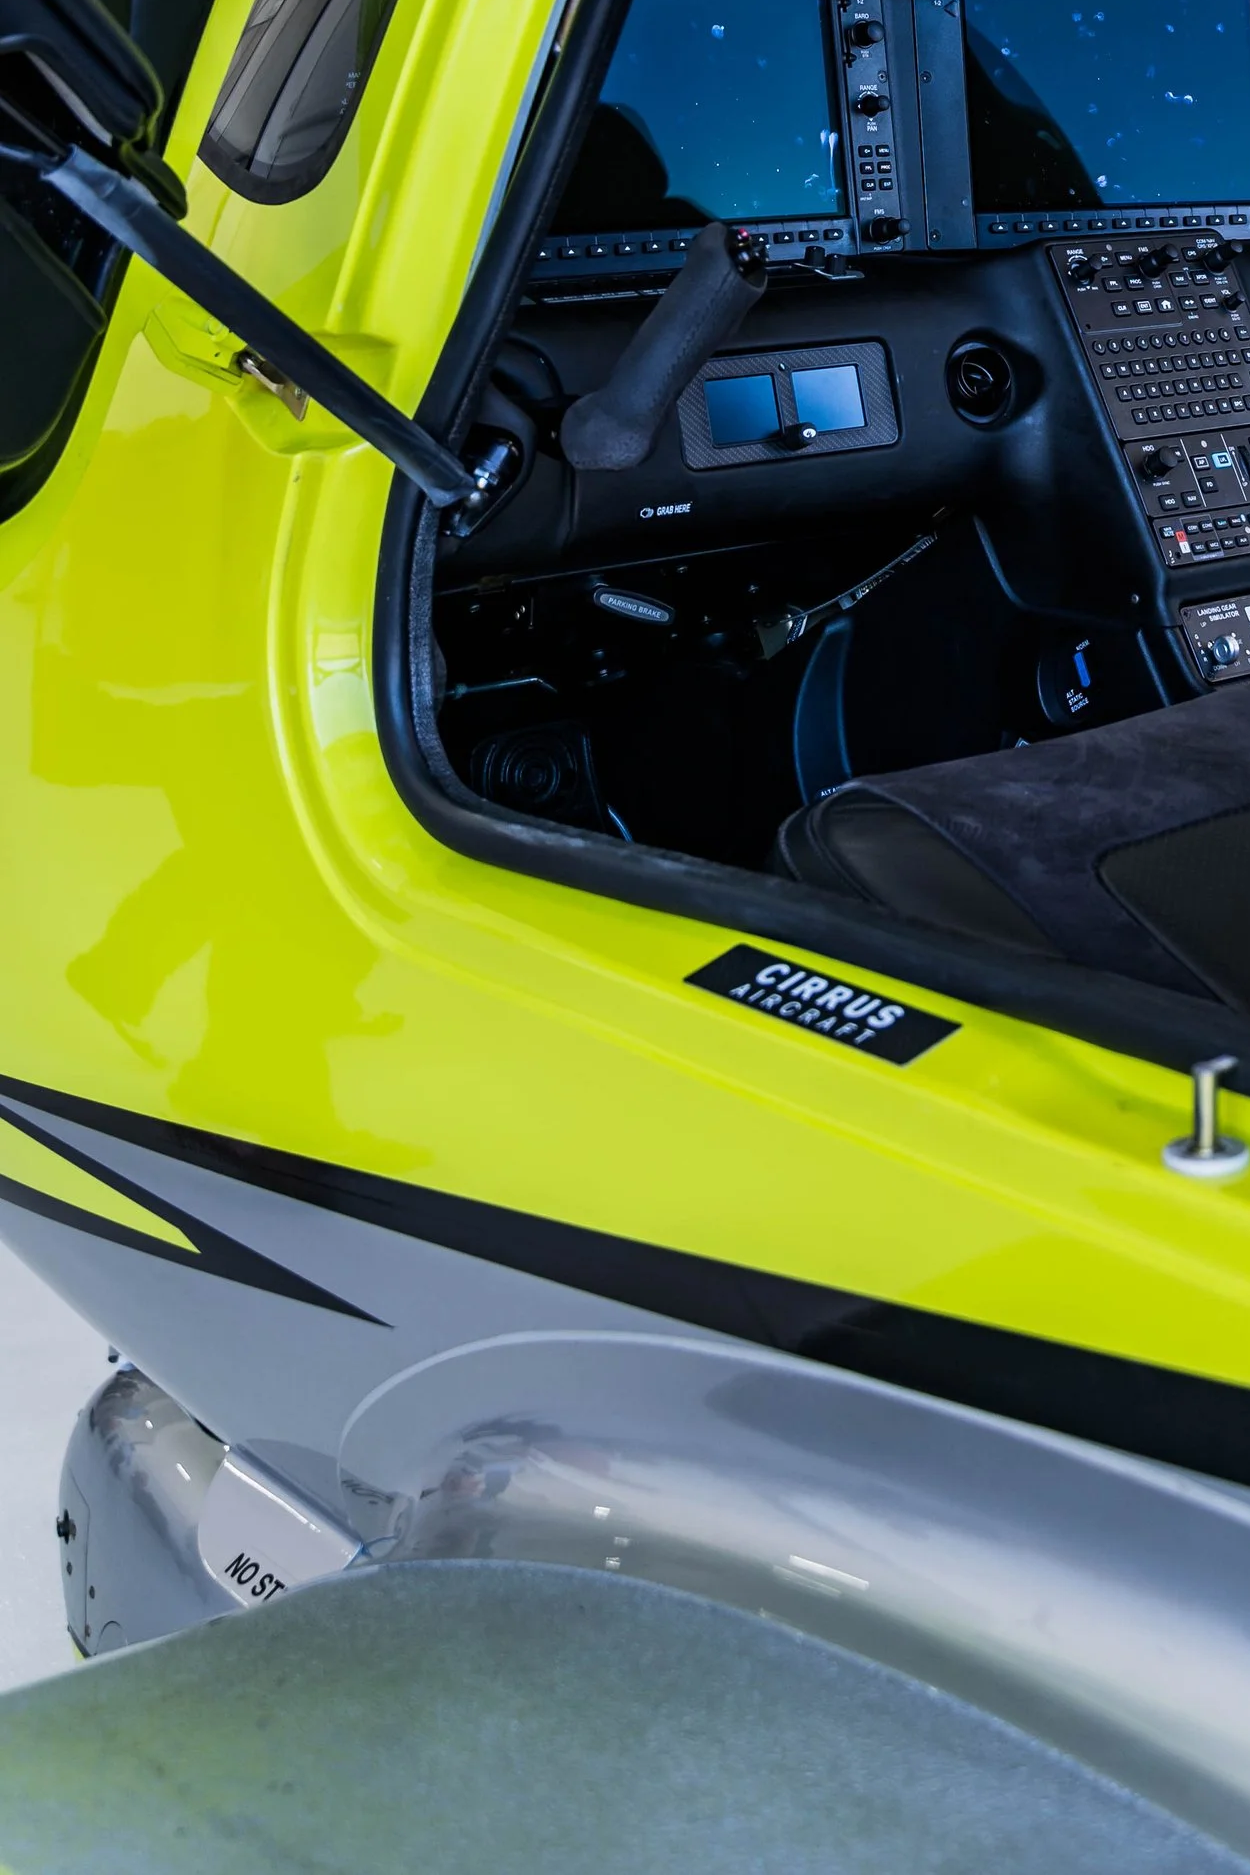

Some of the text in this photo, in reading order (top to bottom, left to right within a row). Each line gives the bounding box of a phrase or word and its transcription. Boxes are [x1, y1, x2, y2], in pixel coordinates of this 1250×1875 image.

[657, 503, 691, 516] GRAB HERE
[607, 597, 662, 619] PARKING BRAKE
[1197, 603, 1237, 616] LANDING GEAR
[1209, 610, 1240, 622] SIMULATOR
[1066, 689, 1075, 699] ALT
[1068, 693, 1084, 706] STATIC
[1071, 697, 1089, 712] SOURCE
[755, 963, 905, 1029] CIRRUS
[729, 983, 877, 1045] AIRCRAFT
[224, 1552, 260, 1585] NO
[251, 1573, 288, 1602] ST
